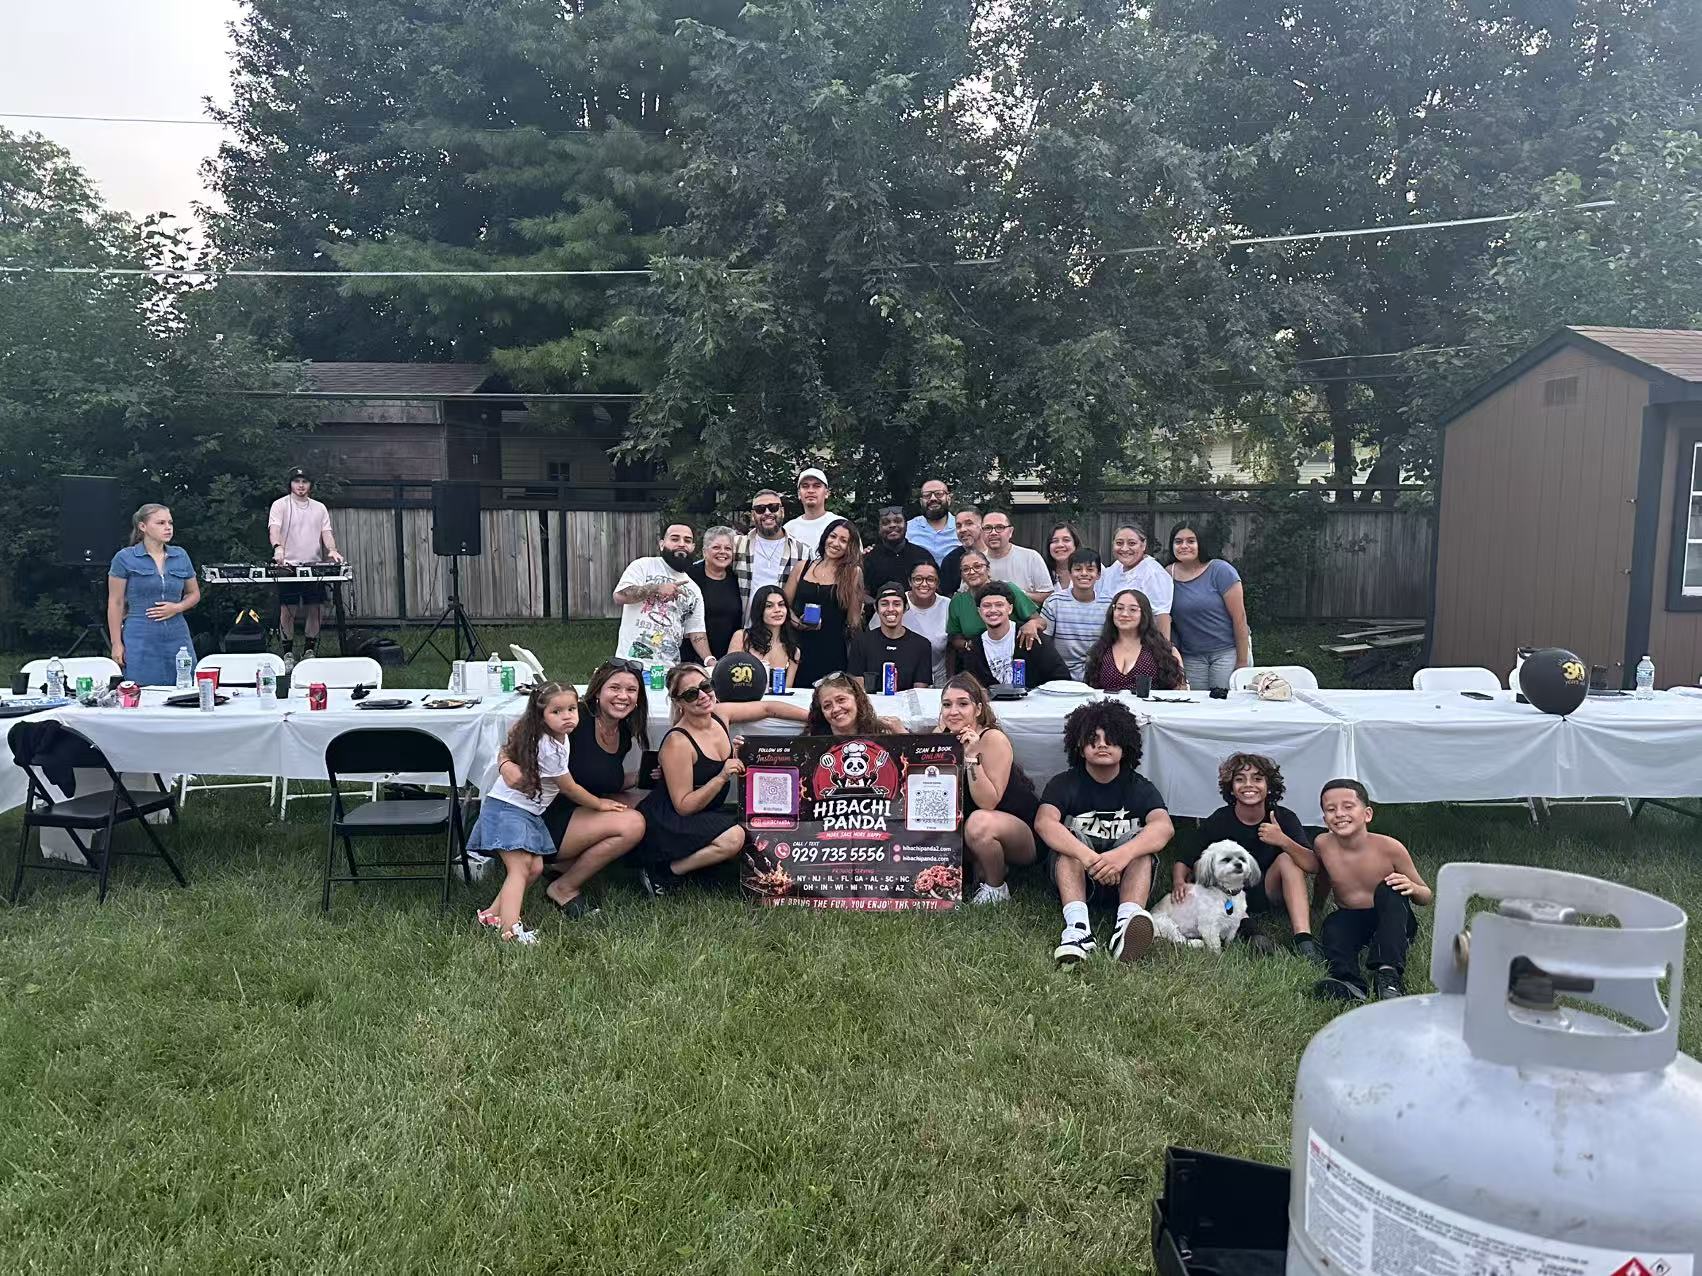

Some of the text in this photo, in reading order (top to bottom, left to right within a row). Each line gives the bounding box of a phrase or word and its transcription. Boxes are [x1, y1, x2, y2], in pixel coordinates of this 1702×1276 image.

[650, 669, 665, 678] Spri
[730, 665, 753, 683] 30
[1562, 661, 1585, 681] 30
[937, 745, 953, 753] BOOK
[756, 754, 791, 764] Instagram
[813, 798, 891, 819] HIBACHI
[822, 814, 887, 831] PANDA
[791, 846, 885, 863] 929 735 5556
[773, 898, 785, 906] WE
[788, 898, 811, 907] BRING
[813, 899, 828, 908] THE
[850, 900, 865, 909] YOU
